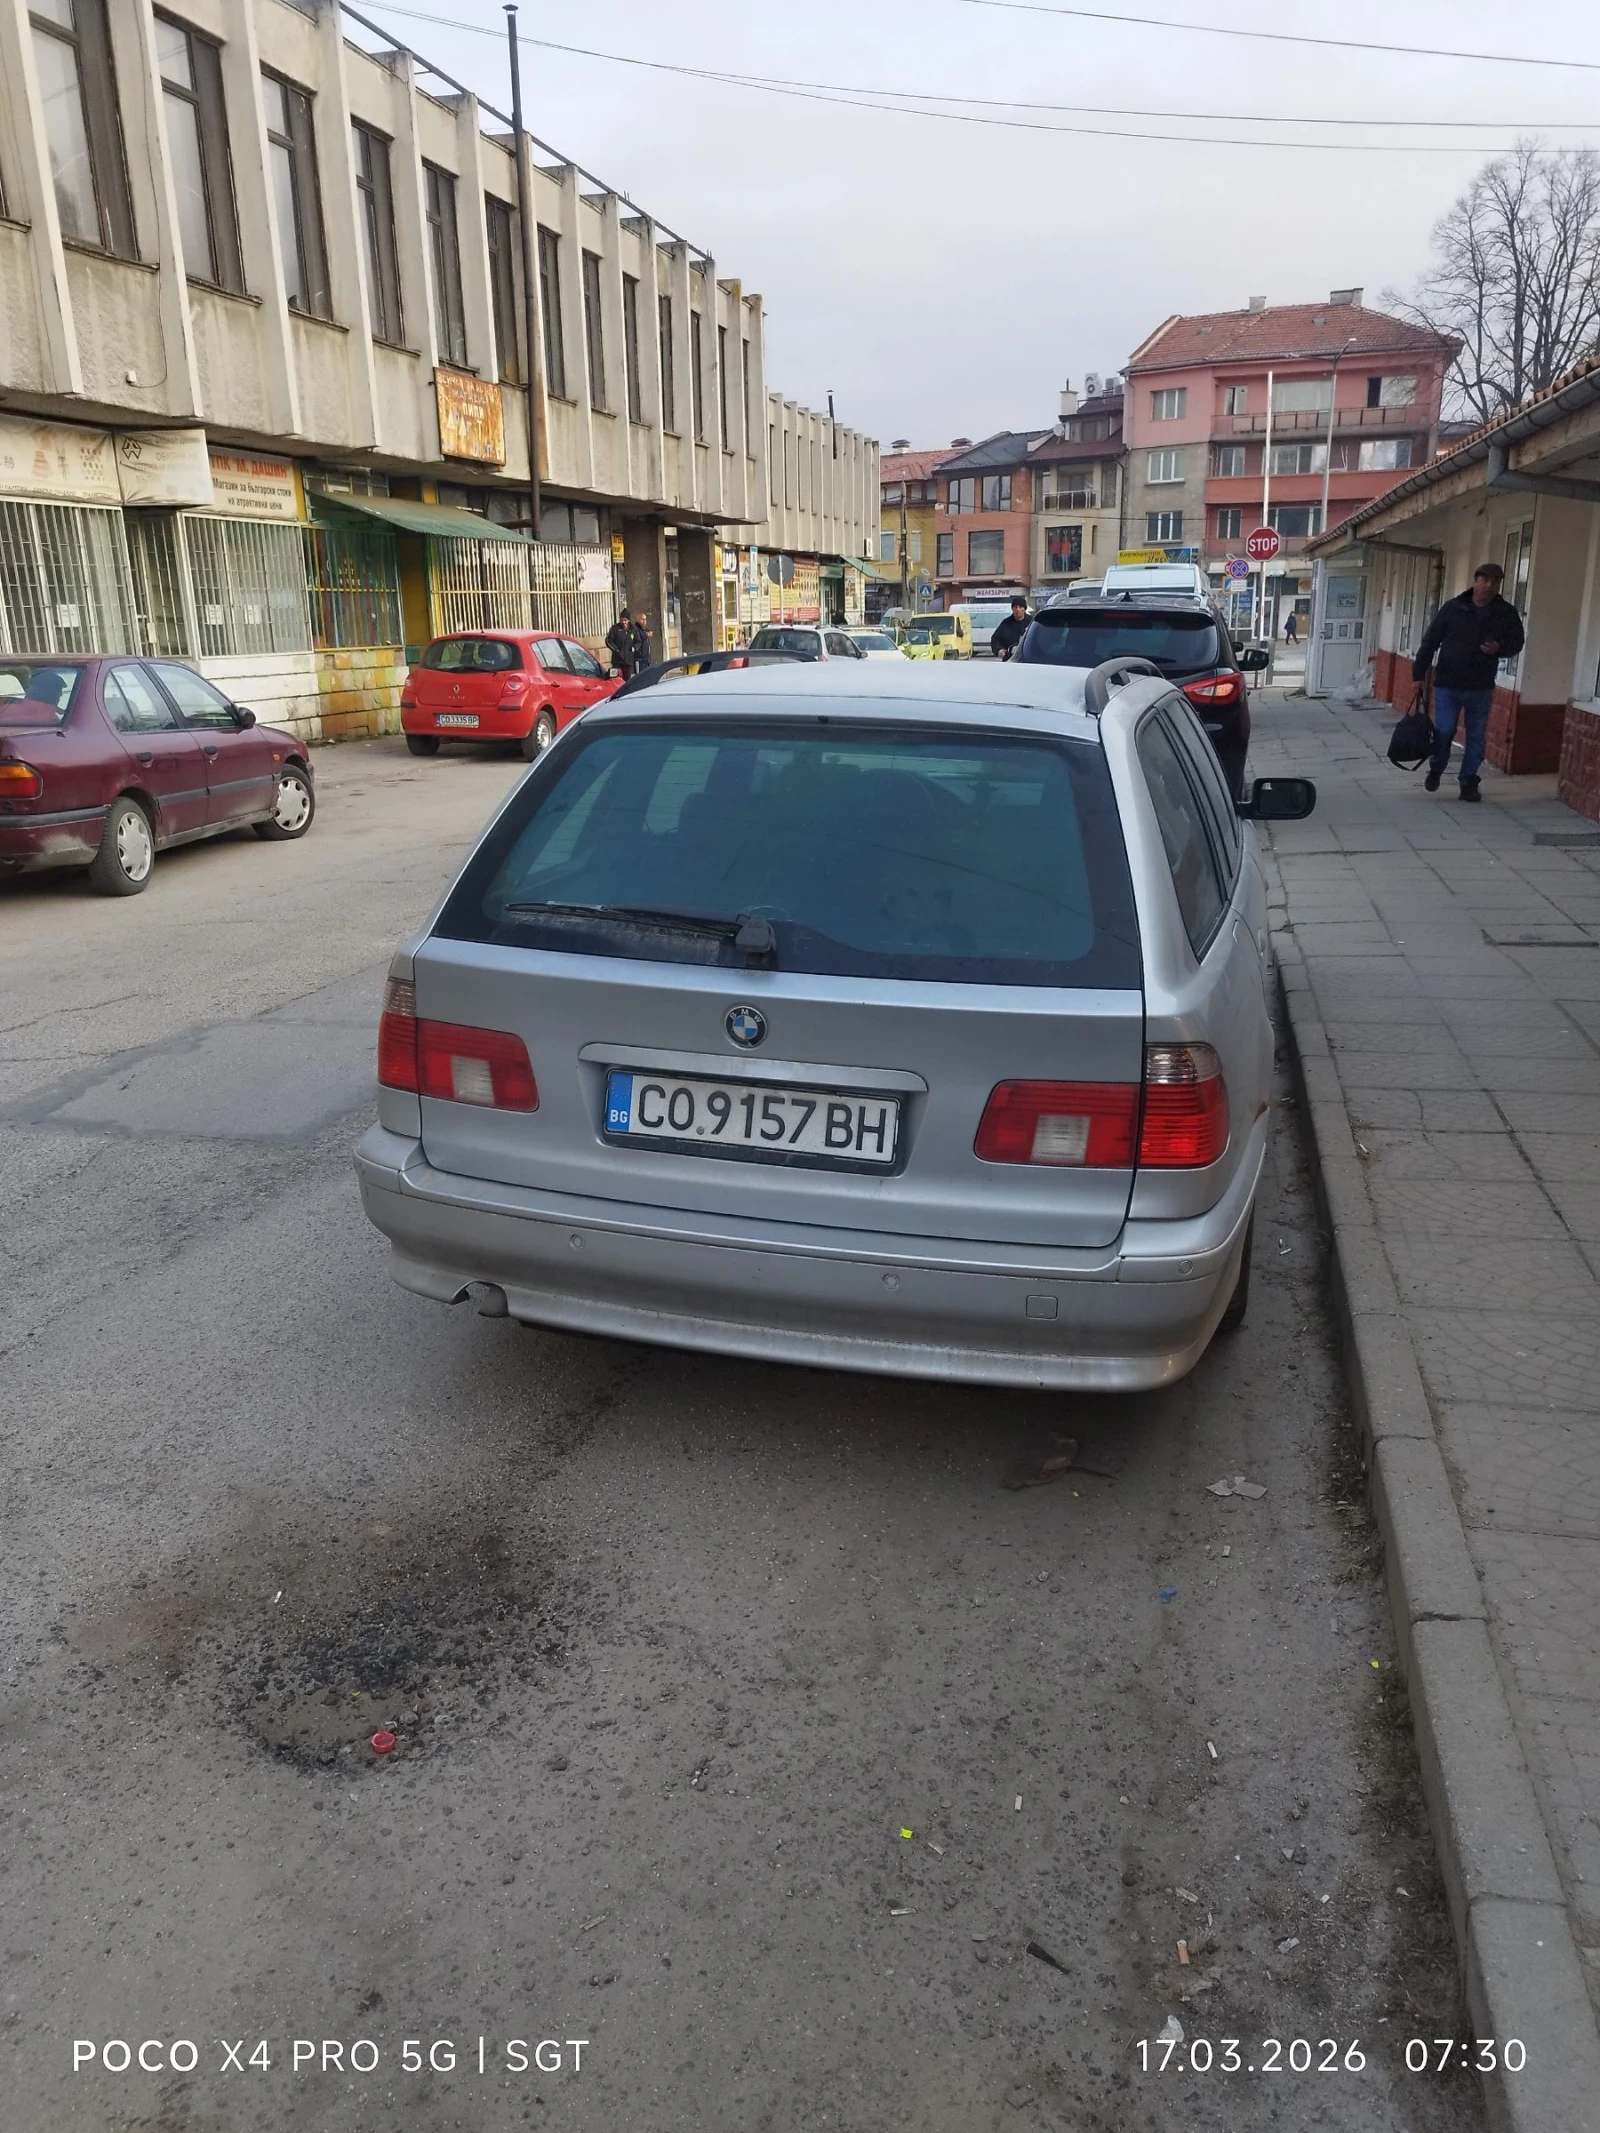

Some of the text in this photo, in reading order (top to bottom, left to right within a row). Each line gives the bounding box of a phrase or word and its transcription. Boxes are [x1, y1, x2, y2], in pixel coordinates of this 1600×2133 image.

[213, 477, 292, 497] Магазин за български стоки
[228, 497, 283, 510] на атрактивни цени
[1248, 537, 1278, 552] STOP
[729, 1008, 763, 1023] BMW
[610, 1109, 628, 1124] BG
[707, 1090, 817, 1145] 9157
